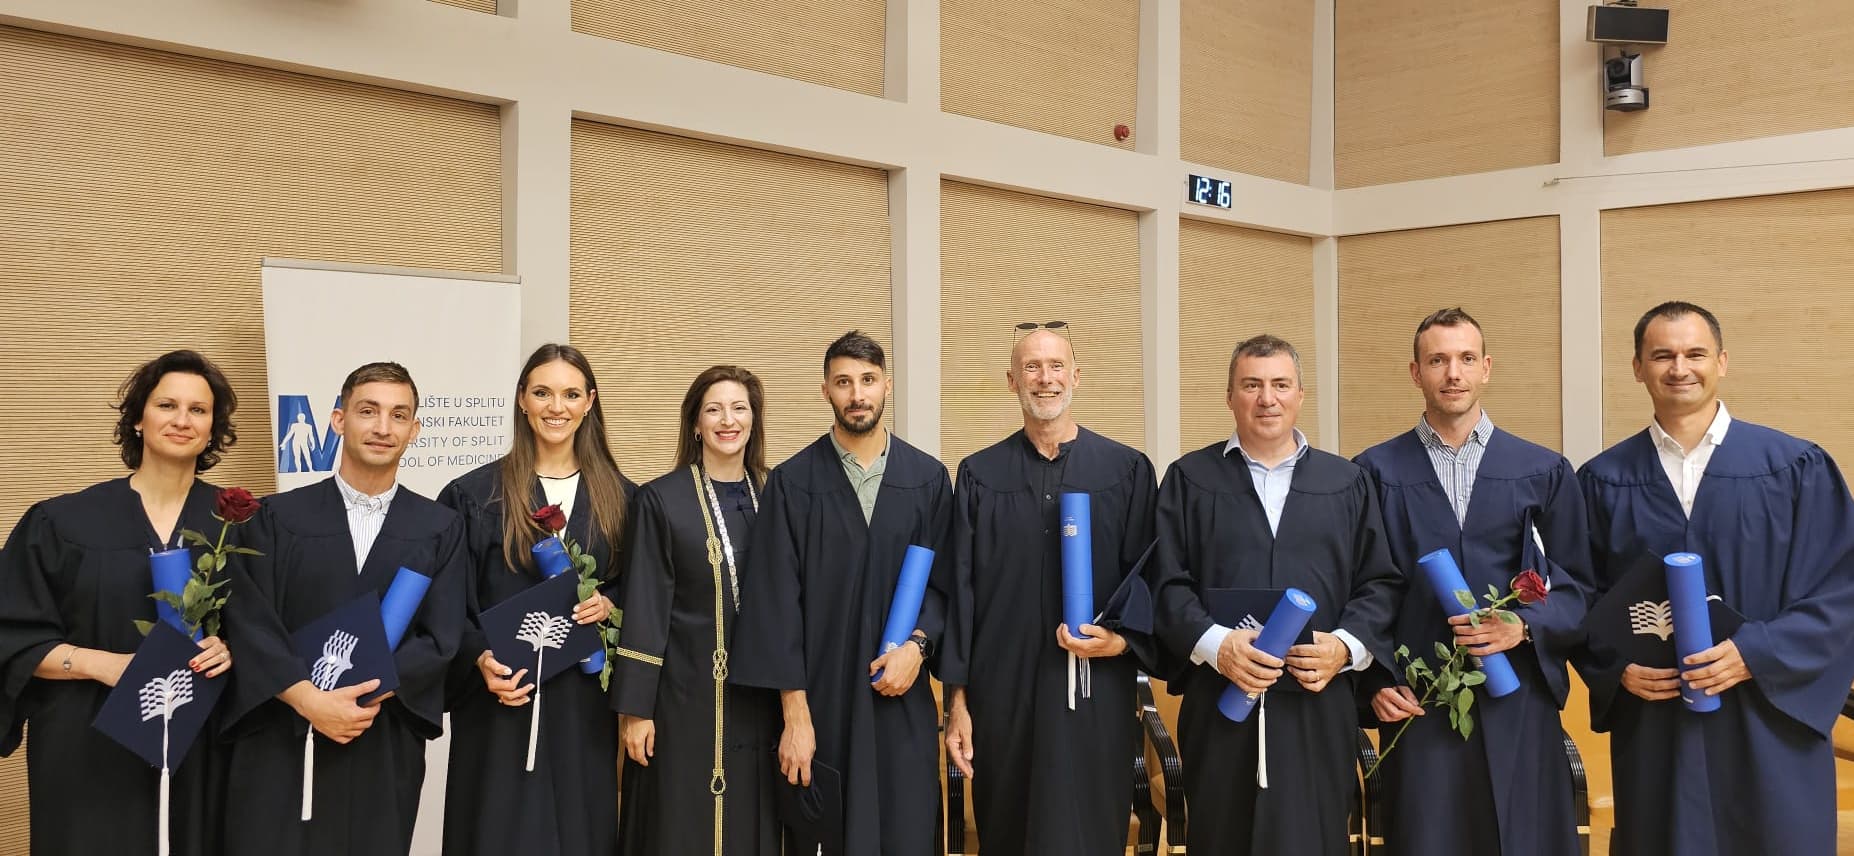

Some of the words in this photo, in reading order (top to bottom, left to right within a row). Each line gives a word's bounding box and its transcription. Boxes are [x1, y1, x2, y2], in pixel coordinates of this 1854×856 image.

[1195, 177, 1230, 208] 12:16
[454, 397, 462, 408] U
[465, 397, 505, 408] SPLITU
[417, 416, 445, 427] NSKI
[448, 415, 504, 427] FAKULTET
[452, 436, 468, 447] OF
[471, 435, 505, 447] SPLIT
[399, 456, 424, 467] OOL
[427, 455, 446, 467] OF
